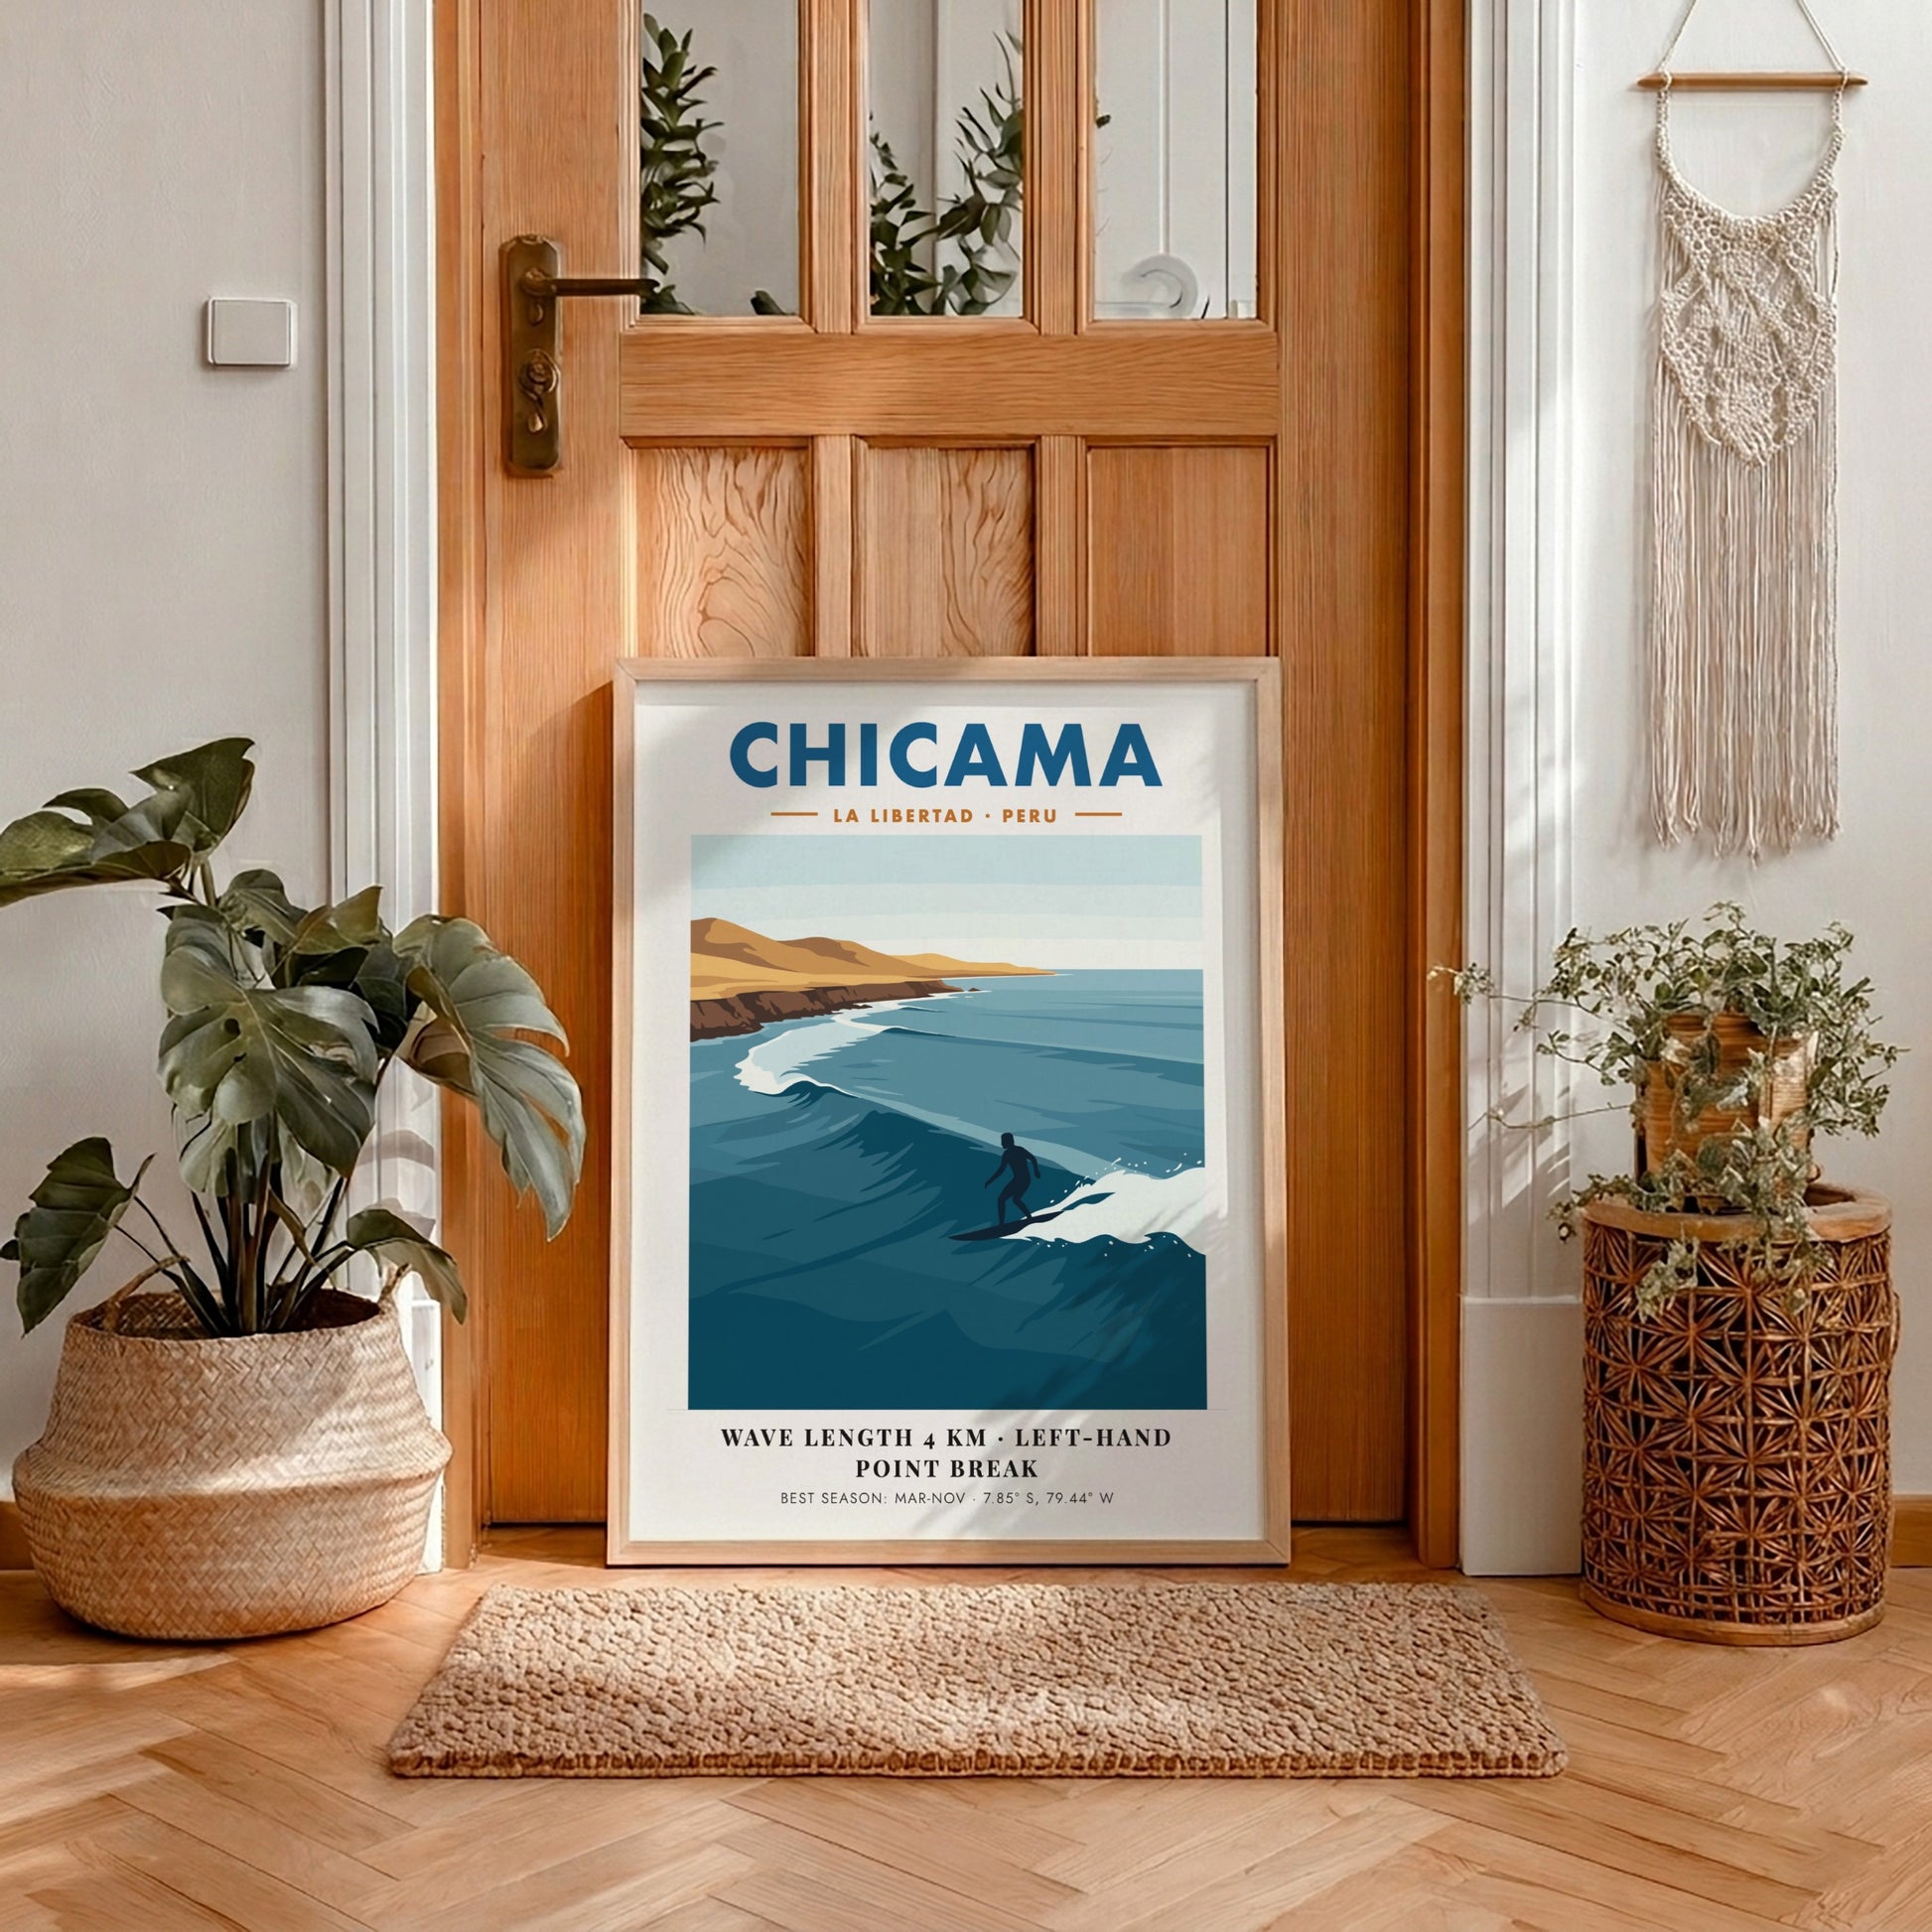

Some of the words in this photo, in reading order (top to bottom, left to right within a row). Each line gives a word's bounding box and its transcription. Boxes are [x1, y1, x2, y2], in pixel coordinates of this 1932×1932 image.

[730, 722, 1164, 788] CHICAMA
[834, 808, 860, 823] LA
[871, 808, 974, 823] LIBERTAD
[1002, 808, 1057, 823] PERU
[721, 1428, 793, 1447] WAVE
[804, 1428, 912, 1448] LENGTH
[923, 1433, 935, 1449] 4
[946, 1428, 987, 1447] KM
[1015, 1428, 1172, 1447] LEFT-HAND
[855, 1458, 940, 1478] POINT
[950, 1458, 1038, 1478] BREAK
[780, 1492, 815, 1504] BEST
[821, 1492, 888, 1504] SEASON:
[895, 1492, 966, 1504] MAR-NOV
[983, 1491, 1020, 1504] 7.85°
[1026, 1491, 1039, 1506] S,
[1046, 1491, 1093, 1504] 79.44°
[1099, 1492, 1114, 1504] W
